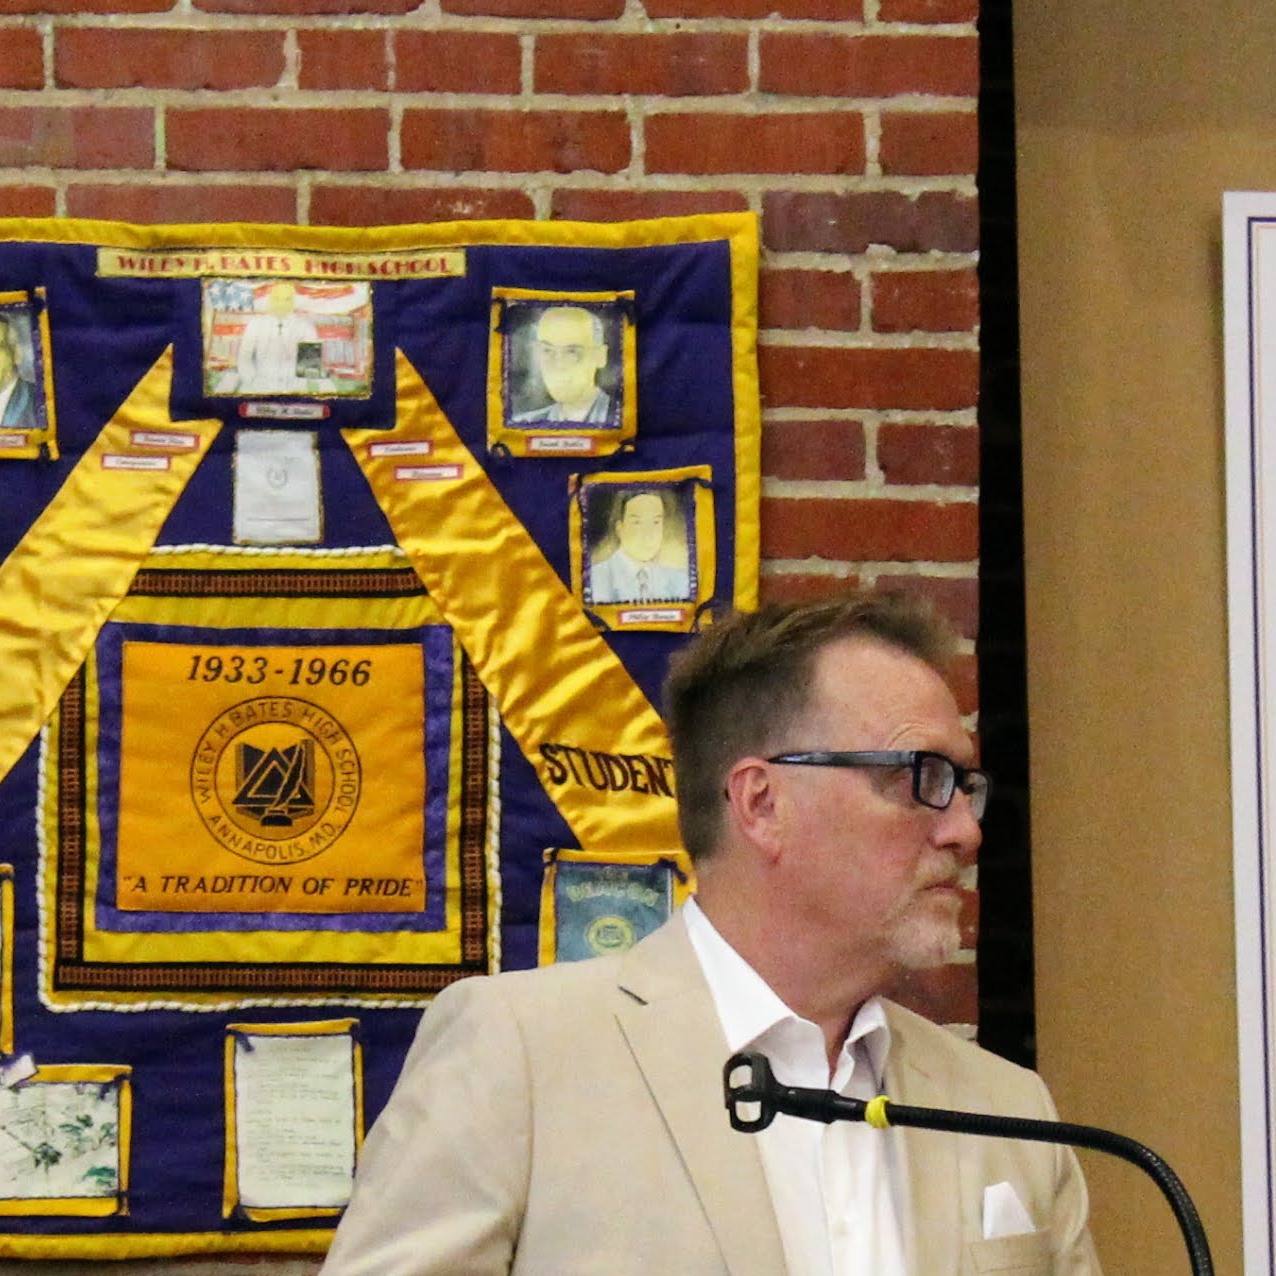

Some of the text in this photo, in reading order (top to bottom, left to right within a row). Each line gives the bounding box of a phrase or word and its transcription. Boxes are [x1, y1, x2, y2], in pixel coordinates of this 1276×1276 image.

[116, 256, 185, 272] WILEY
[221, 255, 291, 272] BATES
[304, 258, 363, 274] HIGH
[367, 257, 452, 275] SCHOOL
[196, 743, 217, 804] WILEY
[228, 701, 294, 725] BATES
[302, 707, 344, 745] HIGH
[334, 748, 357, 813] SCHOOL
[160, 875, 293, 894] TRADITION
[302, 876, 335, 896] OF
